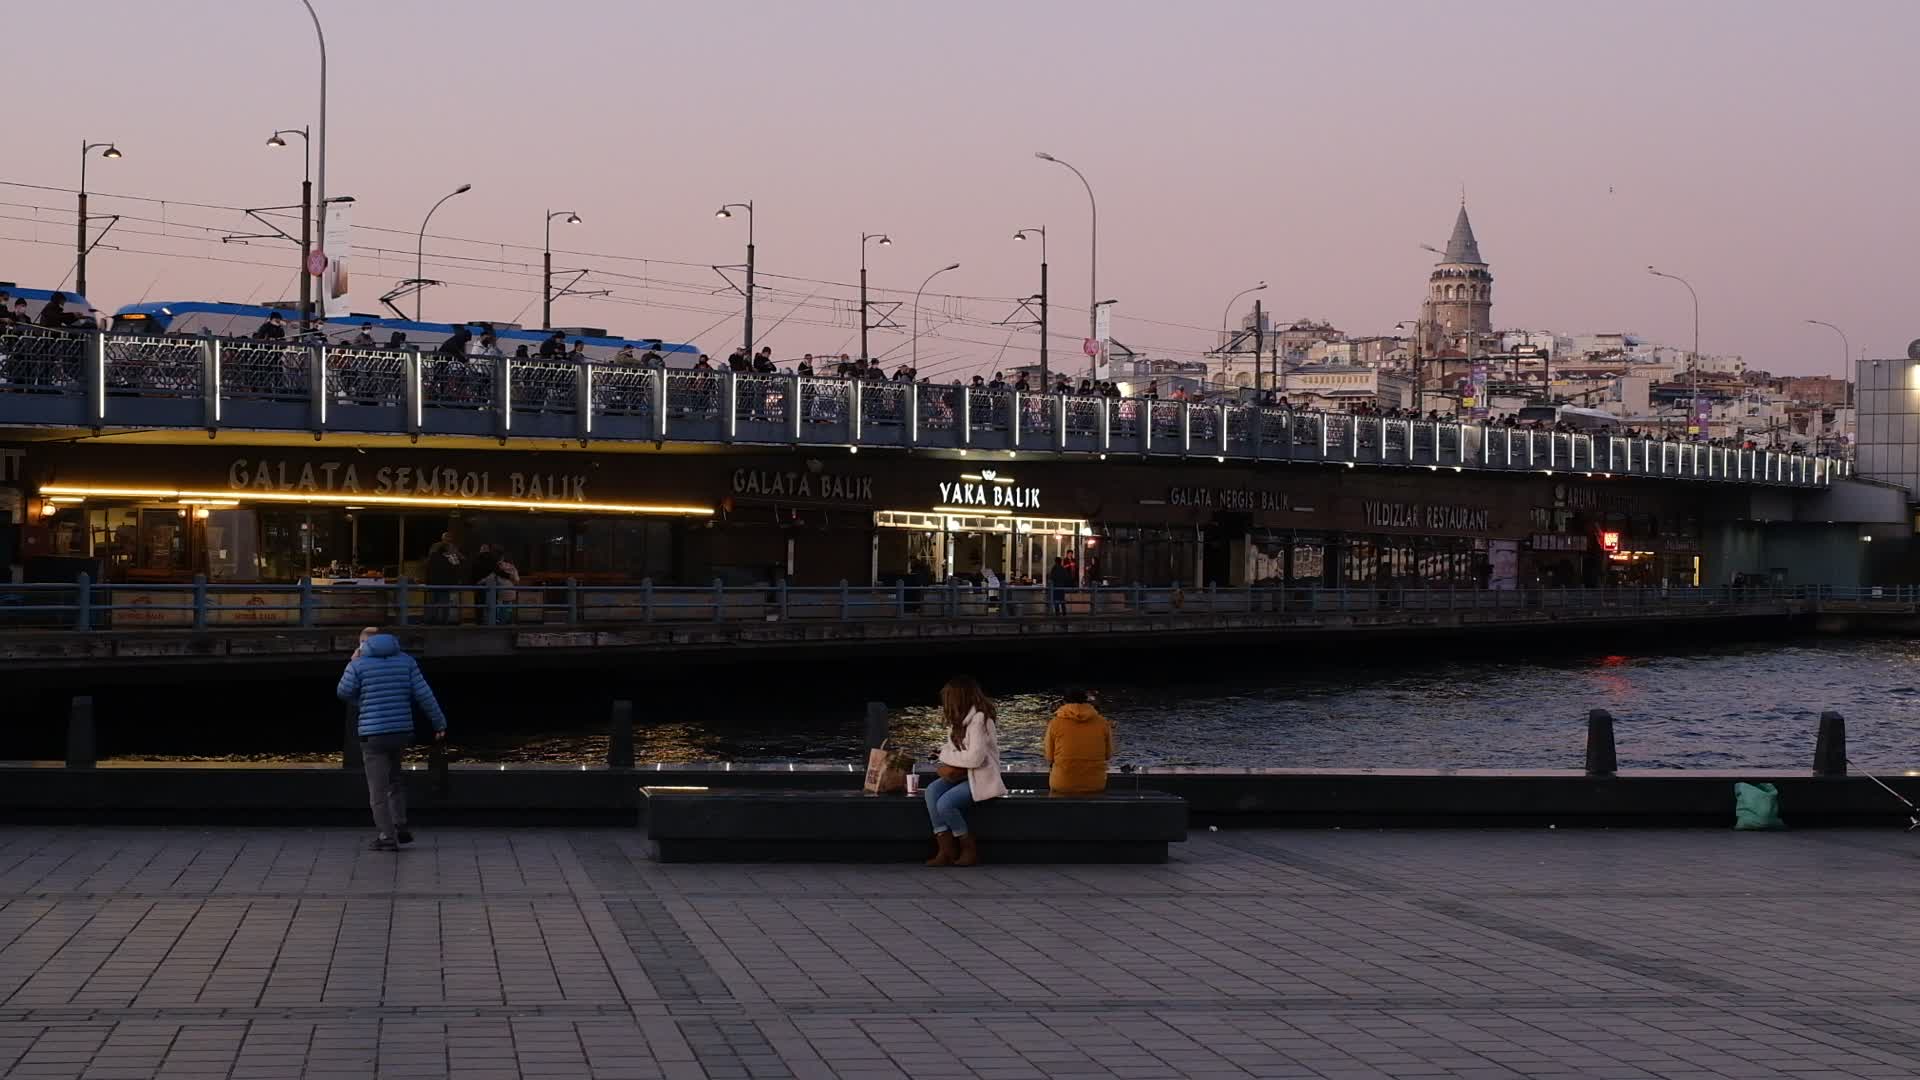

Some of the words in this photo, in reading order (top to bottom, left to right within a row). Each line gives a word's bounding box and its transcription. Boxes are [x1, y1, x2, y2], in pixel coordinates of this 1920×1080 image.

[229, 457, 361, 493] GALATA
[374, 465, 496, 497] SEMBOL
[509, 472, 587, 502] BALIK
[733, 467, 811, 497] GALATA
[820, 474, 873, 501] BALIK
[939, 482, 987, 505] YAKA
[993, 486, 1041, 509] BALIK
[1170, 487, 1212, 506] GALATA
[1261, 491, 1289, 511] BALIK
[1366, 501, 1418, 527] YILDIZLAR
[1426, 505, 1489, 530] RESTAURANT
